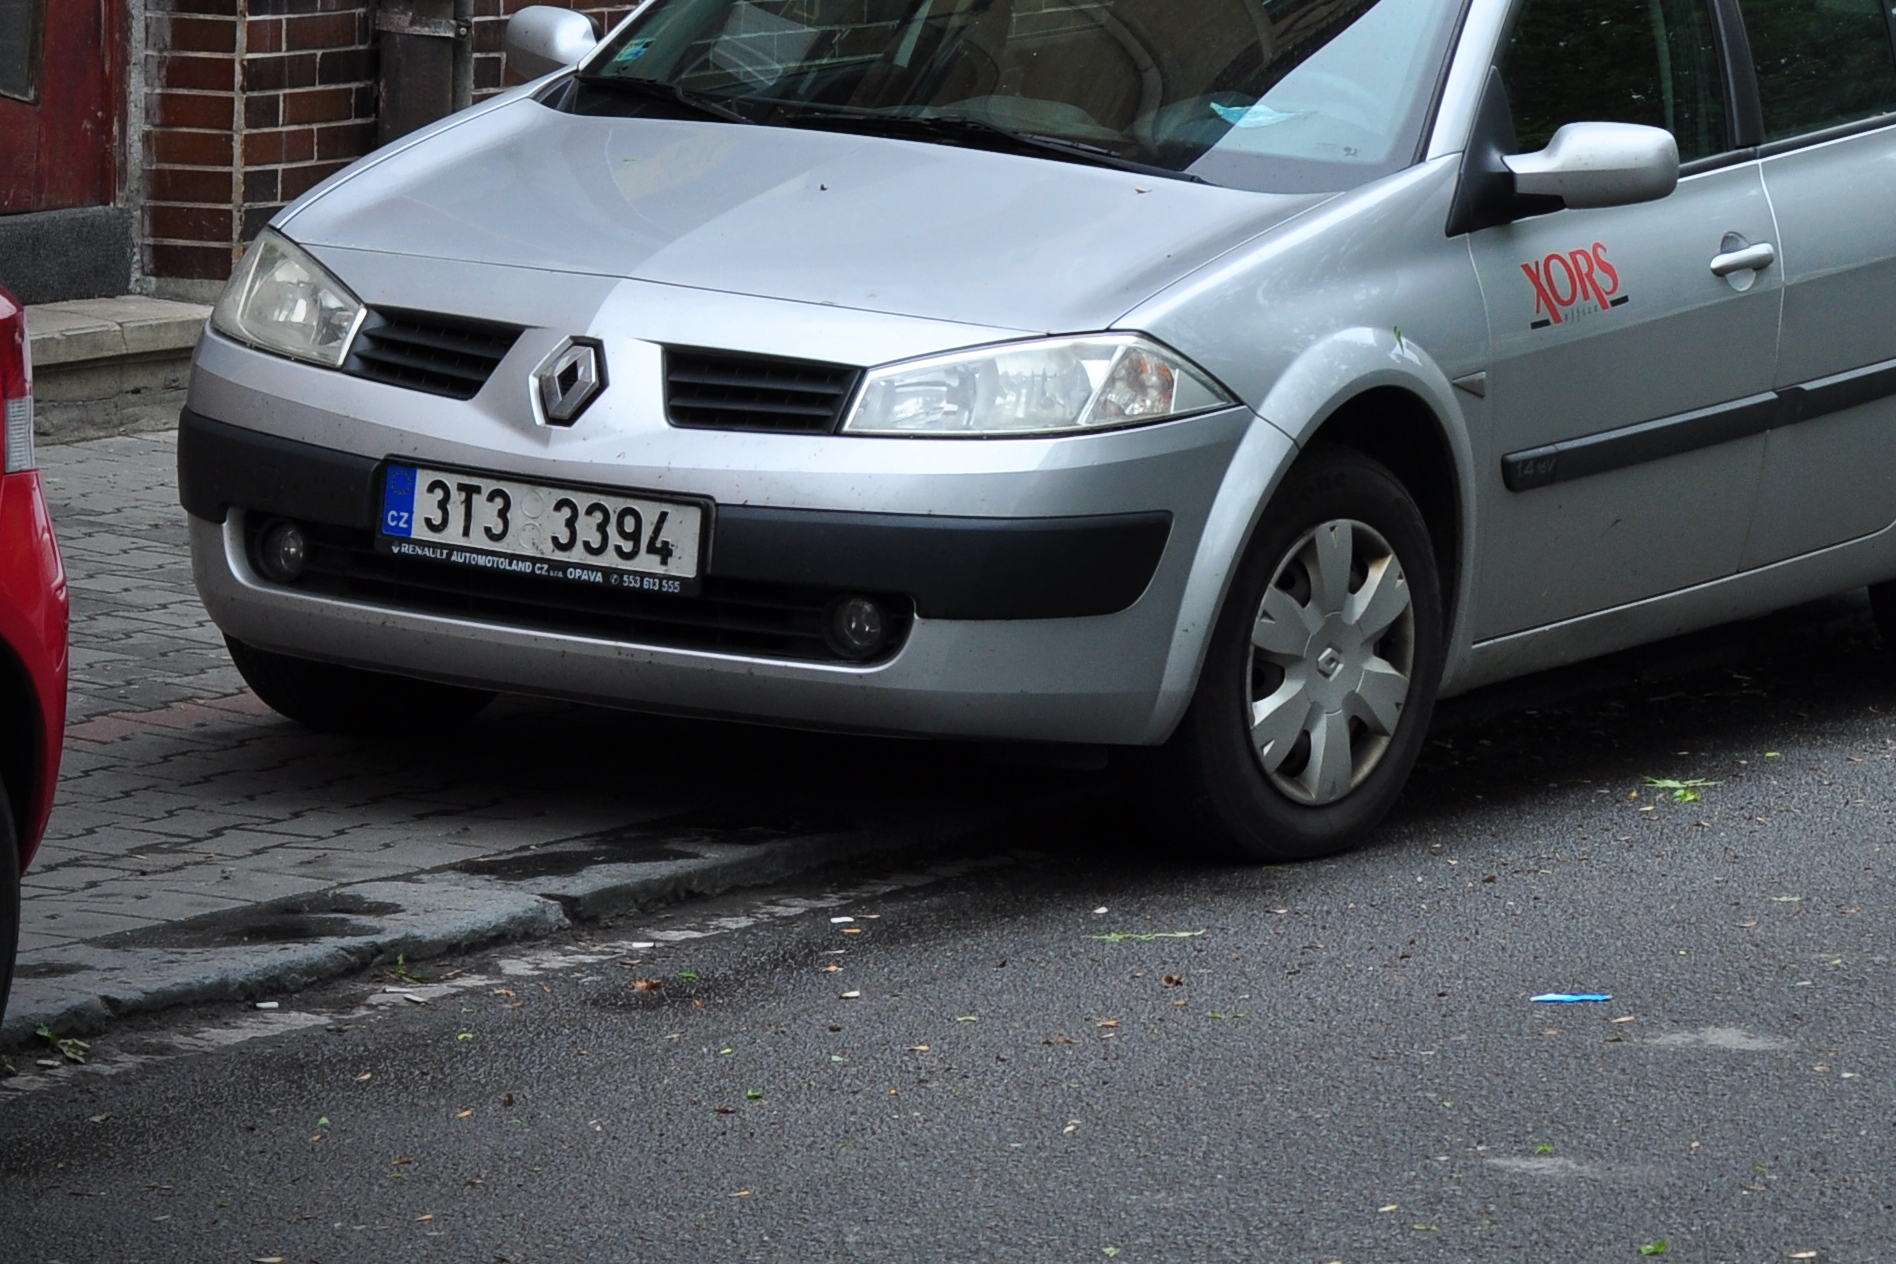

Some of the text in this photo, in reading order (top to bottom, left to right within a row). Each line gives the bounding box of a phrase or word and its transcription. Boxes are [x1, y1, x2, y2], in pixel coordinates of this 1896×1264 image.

[1520, 242, 1619, 325] XORS
[387, 510, 409, 529] CZ
[423, 479, 674, 566] 3T3 3394
[401, 543, 449, 560] RENAULT
[451, 551, 532, 574] AUTOMOTOLAND
[535, 563, 549, 576] CZ
[567, 567, 603, 583] OPAVA
[622, 574, 641, 587] 553
[643, 577, 660, 590] 613
[662, 579, 680, 593] 555
